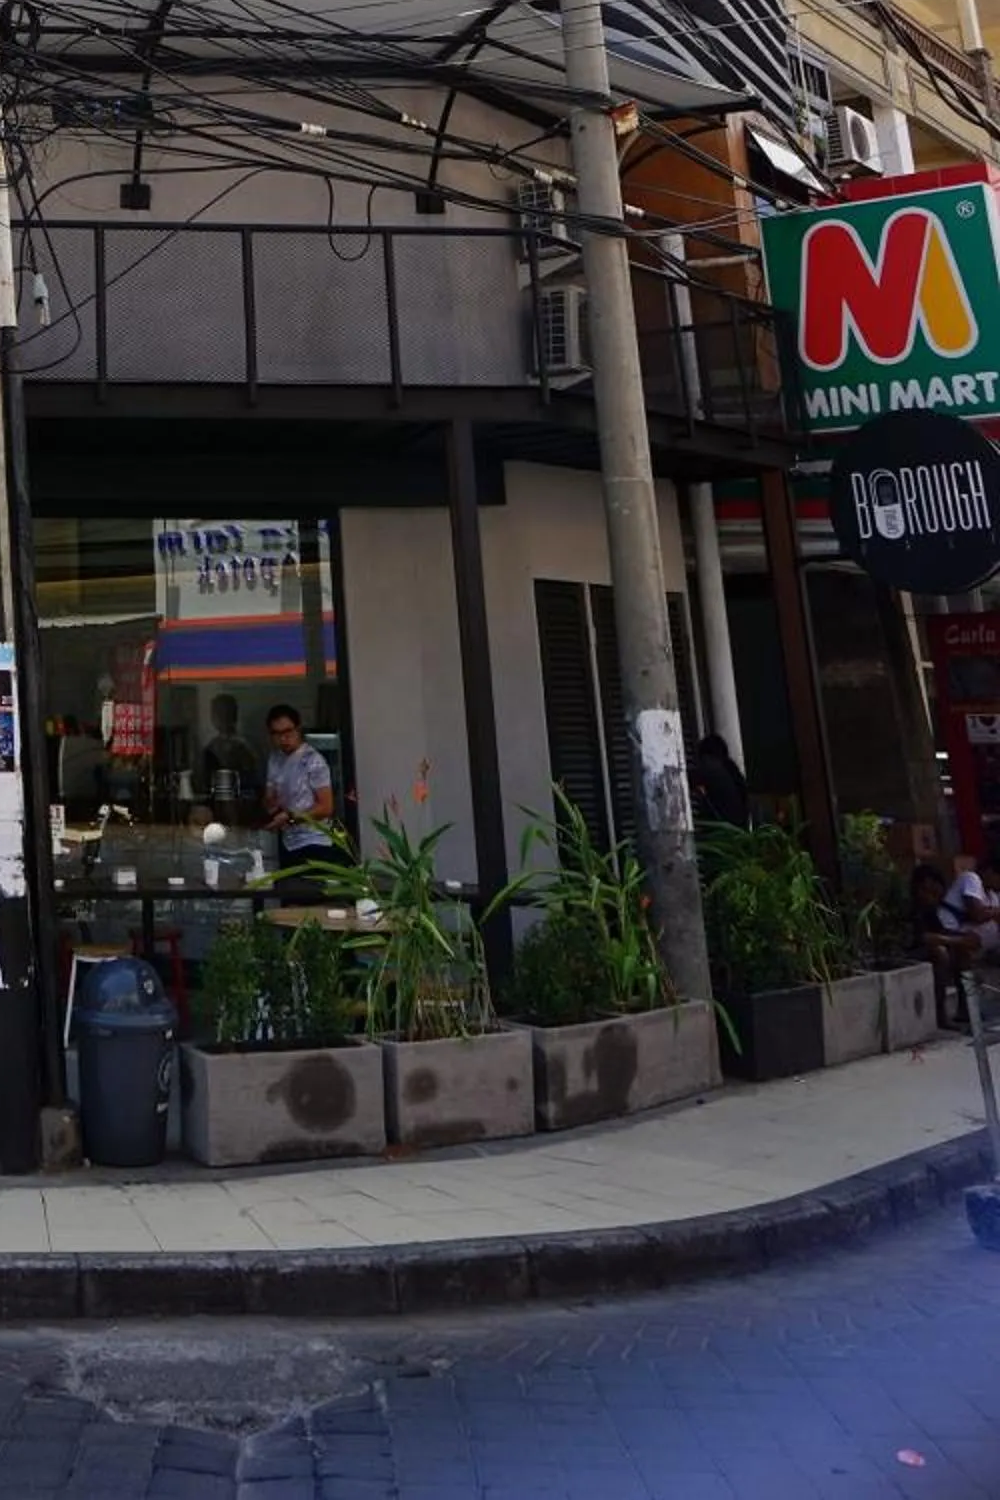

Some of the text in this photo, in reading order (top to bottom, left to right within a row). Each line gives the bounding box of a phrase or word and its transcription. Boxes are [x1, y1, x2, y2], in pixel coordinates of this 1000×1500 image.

[804, 371, 999, 419] MINI MART
[851, 459, 992, 540] BOROUGH
